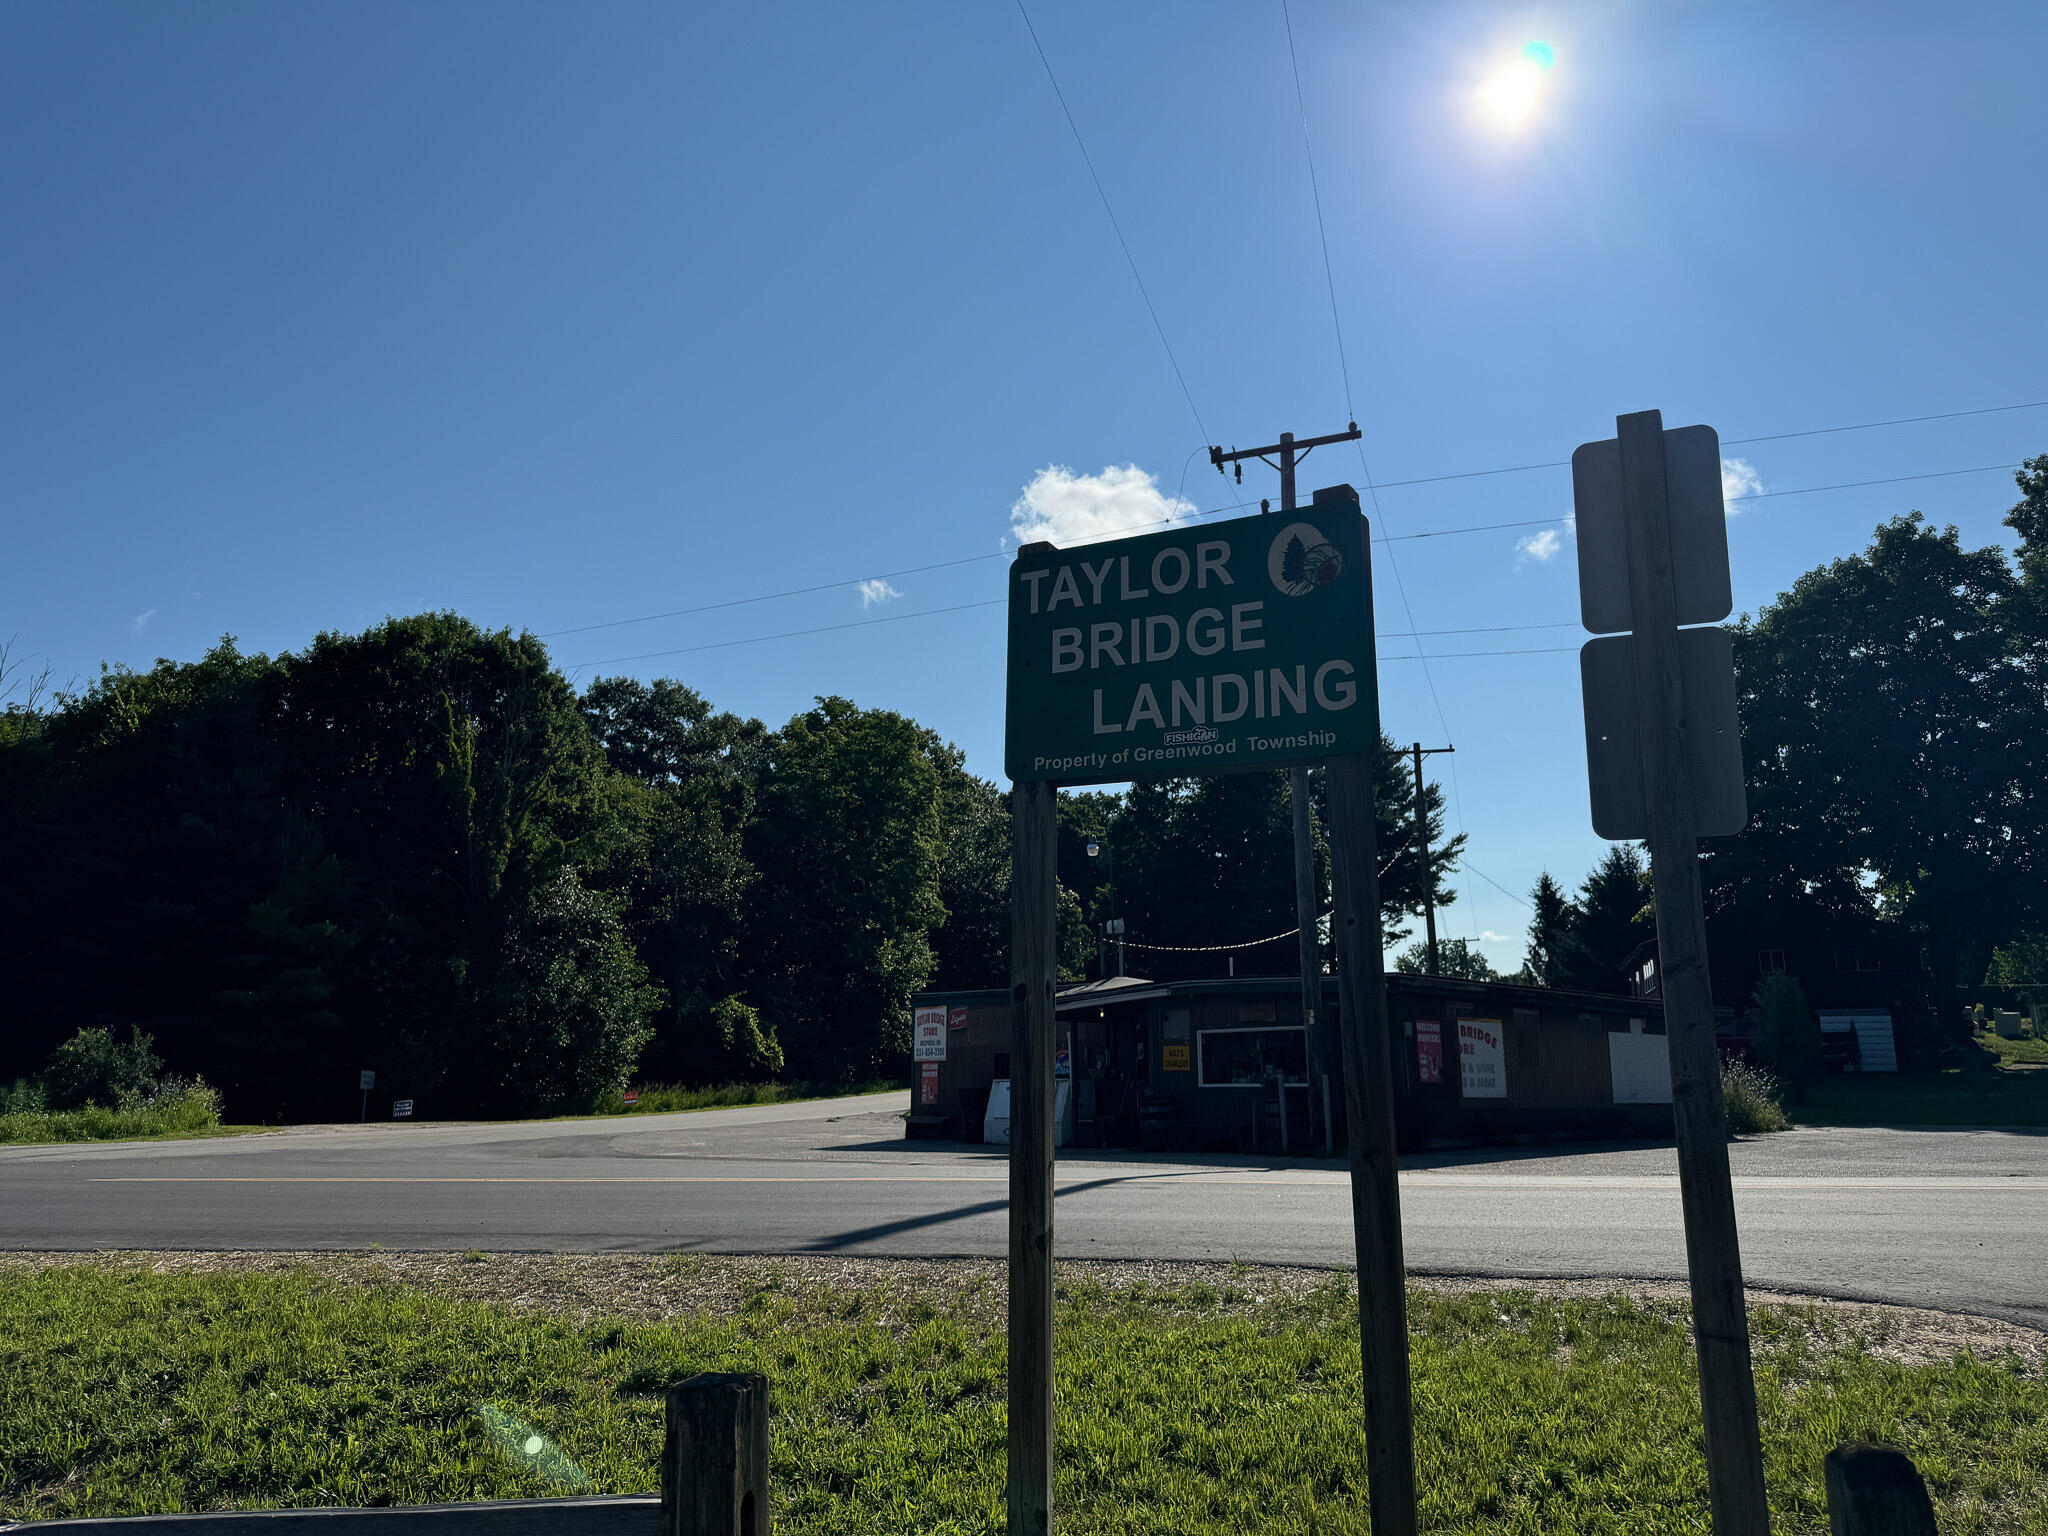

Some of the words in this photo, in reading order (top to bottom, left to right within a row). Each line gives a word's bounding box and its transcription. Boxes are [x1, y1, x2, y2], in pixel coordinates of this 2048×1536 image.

[1020, 540, 1235, 614] TAYLOR
[1051, 601, 1266, 673] BRIDGE
[1093, 660, 1357, 735] LANDING
[1034, 752, 1107, 771] Property
[1112, 749, 1130, 764] of
[1134, 738, 1237, 762] Greenwood
[1247, 730, 1337, 752] Township
[1165, 727, 1217, 744] FISHIGAN
[923, 1027, 938, 1037] STORE
[1460, 1025, 1497, 1049] BRIDGE
